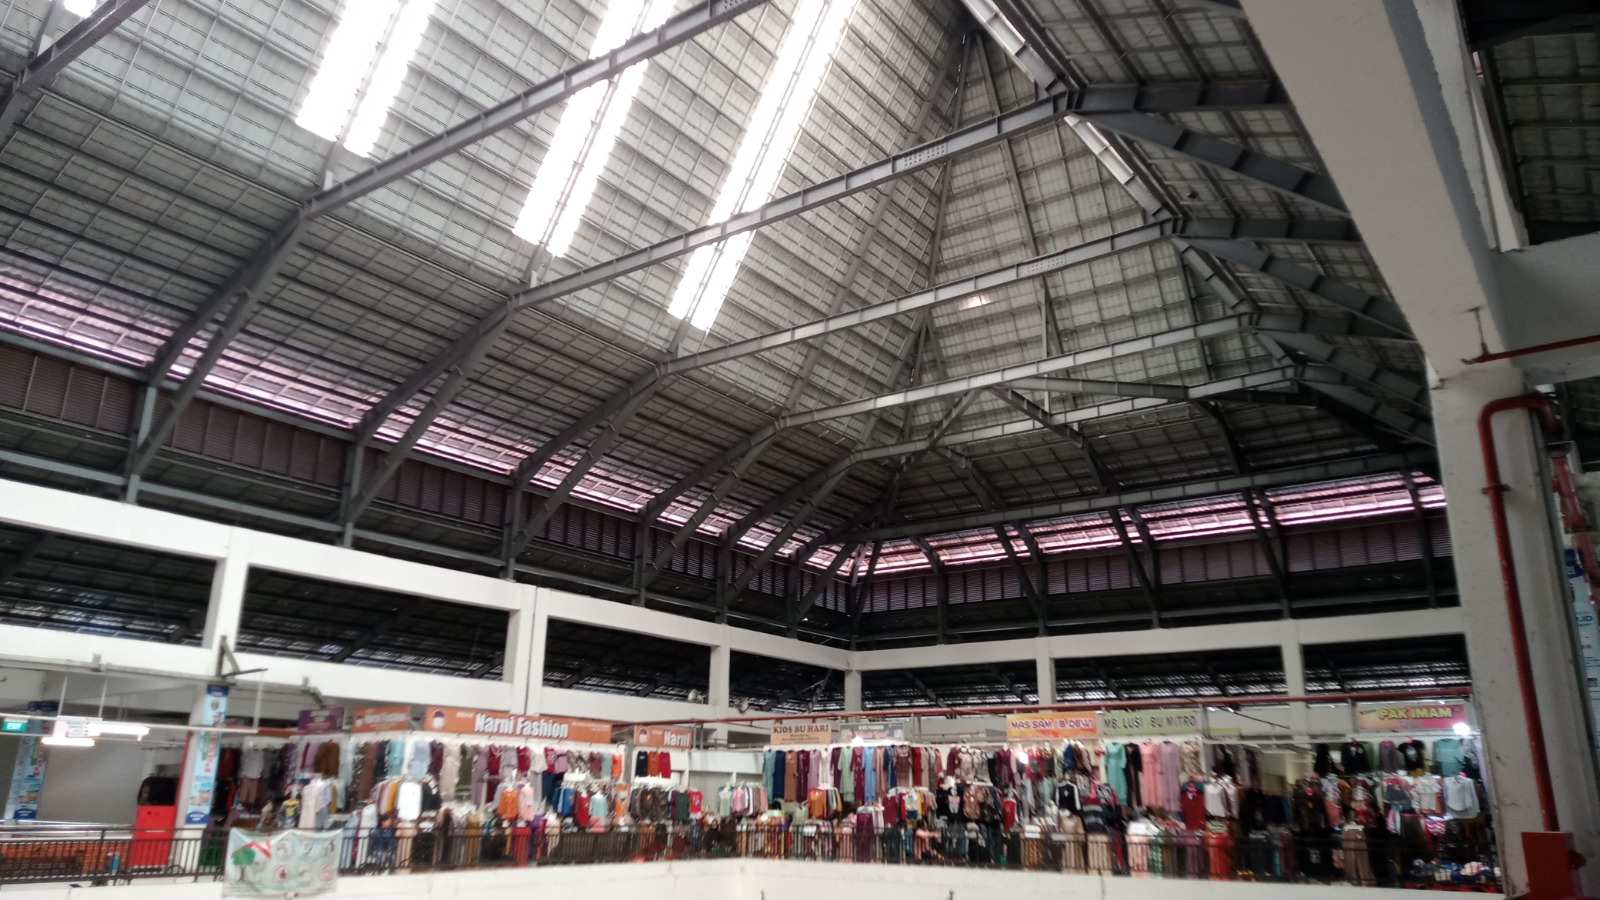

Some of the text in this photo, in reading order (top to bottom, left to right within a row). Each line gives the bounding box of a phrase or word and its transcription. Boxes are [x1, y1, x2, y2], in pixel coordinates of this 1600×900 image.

[1378, 707, 1408, 720] PAK
[1411, 706, 1453, 718] IMAM
[474, 713, 515, 734] Narni
[516, 717, 569, 739] Fashion
[773, 724, 829, 734] KIOS BU HARI
[1011, 720, 1031, 729] MAS
[1032, 719, 1052, 729] SAM
[1122, 717, 1143, 729] LUSI
[1151, 716, 1163, 728] BU
[1166, 715, 1196, 727] MITRO
[663, 730, 691, 747] Narni
